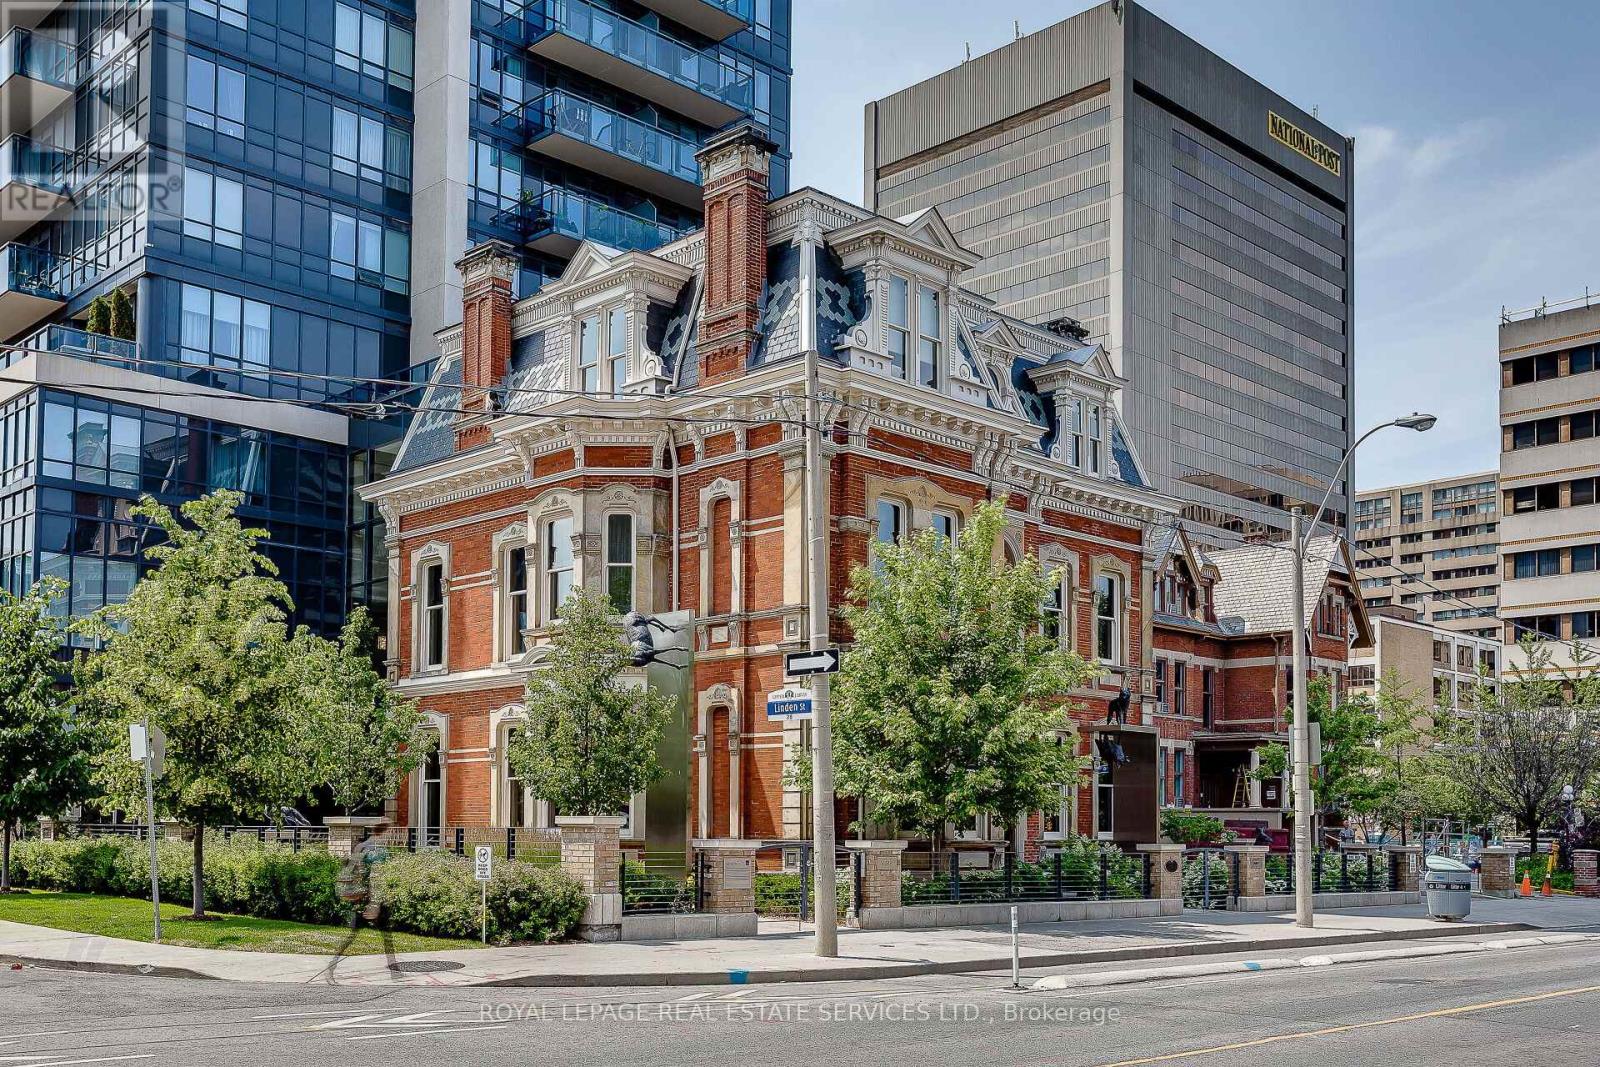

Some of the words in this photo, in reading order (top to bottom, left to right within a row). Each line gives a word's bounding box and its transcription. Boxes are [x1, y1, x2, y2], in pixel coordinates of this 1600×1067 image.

[1270, 113, 1317, 160] NATIONAL
[1318, 143, 1341, 173] POST
[774, 703, 798, 713] Linden
[799, 702, 806, 711] St
